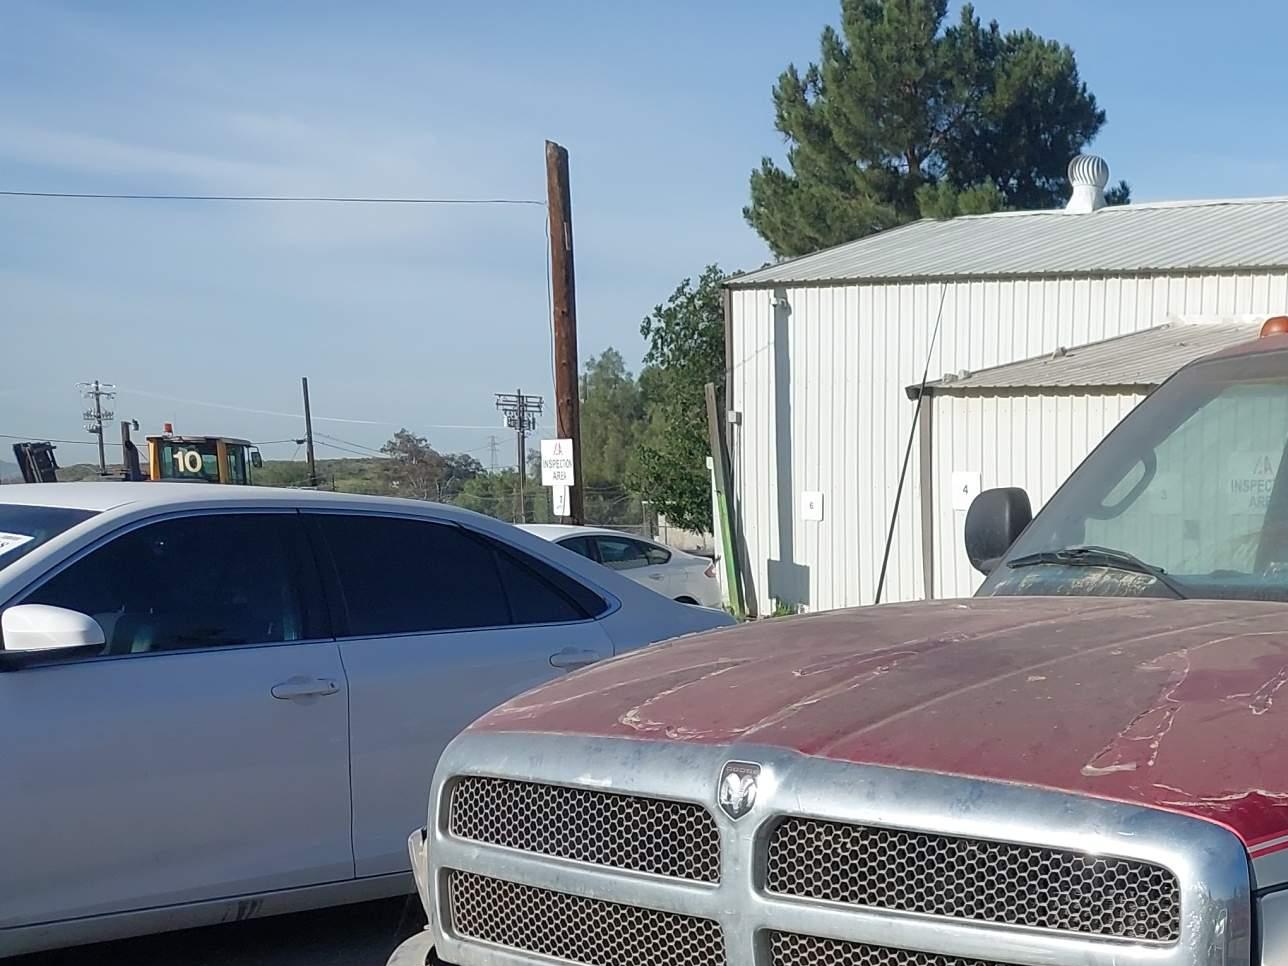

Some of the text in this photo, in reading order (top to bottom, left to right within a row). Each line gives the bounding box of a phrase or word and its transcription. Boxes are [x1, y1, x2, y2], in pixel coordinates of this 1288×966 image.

[172, 450, 203, 474] 10
[543, 458, 573, 469] INSPECTION
[552, 471, 567, 482] AREA
[962, 484, 969, 497] 4
[1231, 479, 1273, 493] INSPEC
